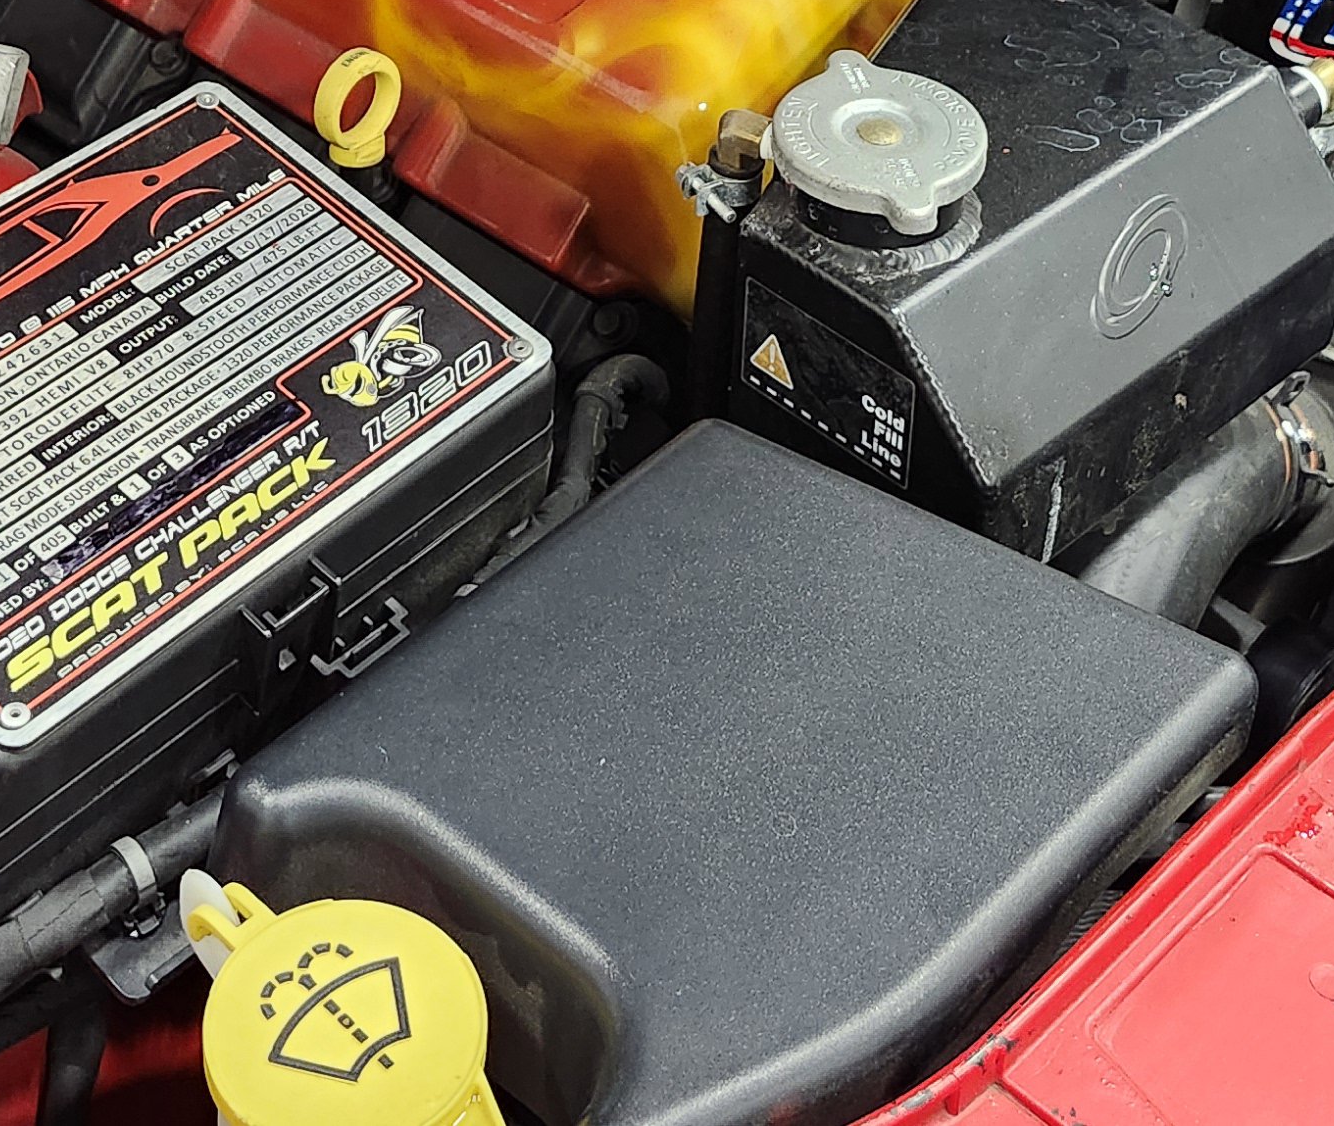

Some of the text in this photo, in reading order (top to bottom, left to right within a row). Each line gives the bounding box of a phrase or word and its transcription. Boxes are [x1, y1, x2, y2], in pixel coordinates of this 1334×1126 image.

[47, 294, 76, 318] 115
[79, 262, 129, 298] MPH
[132, 199, 233, 266] QUARTER
[236, 167, 285, 202] MILE
[78, 202, 274, 324] MODEL: SCAT PACK 1320
[153, 201, 318, 304] BUILD DATE: 10/17/2020
[22, 340, 92, 387] ONTARIO
[89, 302, 153, 345] CANADA
[39, 244, 371, 461] INTERIOR: BLACK HOUNDSTOOTH PERFORMANCE CLOTH
[116, 312, 180, 355] OUTPUT:
[196, 284, 227, 305] 485
[223, 271, 248, 288] HP
[245, 261, 261, 274] /
[259, 245, 289, 265] 475
[121, 342, 176, 379] 8HP70
[180, 296, 248, 341] 8-SPEED
[251, 236, 342, 296] AUTOMATIC
[7, 483, 48, 512] SCAT
[42, 461, 82, 489] PACK
[77, 442, 110, 466] 6.4L
[105, 419, 144, 447] HEMI
[140, 407, 163, 424] V8
[158, 370, 219, 412] PACKAGE
[221, 346, 255, 371] 1320
[249, 290, 340, 352] PERFORMANCE
[334, 258, 389, 296] PACKAGE
[23, 500, 67, 532] MODE
[61, 451, 141, 506] SUSPENSION
[142, 397, 221, 452] TRANSBRAKE
[221, 362, 274, 399] BREMBO
[269, 335, 314, 367] BRAKES
[314, 313, 347, 337] REAR
[342, 296, 372, 318] SEAT
[367, 272, 408, 301] DELETE
[34, 375, 82, 407] HEMI
[83, 357, 109, 376] V8
[360, 338, 496, 452] 1320
[861, 394, 905, 433] Cold
[874, 419, 903, 451] Fill
[11, 551, 40, 573] OF
[37, 530, 69, 554] 405
[67, 501, 113, 535] BUILT
[107, 491, 127, 507] &
[127, 479, 143, 492] 1
[144, 461, 171, 482] OF
[169, 451, 185, 464] 3
[185, 435, 211, 454] AS
[205, 389, 279, 441] OPTIONED
[861, 430, 902, 468] Line
[1, 435, 340, 693] SCAT PACK
[47, 553, 133, 621] DODGE
[133, 449, 282, 561] CHALLENGER
[281, 419, 325, 456] R/T
[19, 575, 51, 599] BY:
[55, 589, 177, 679] PRODUCED
